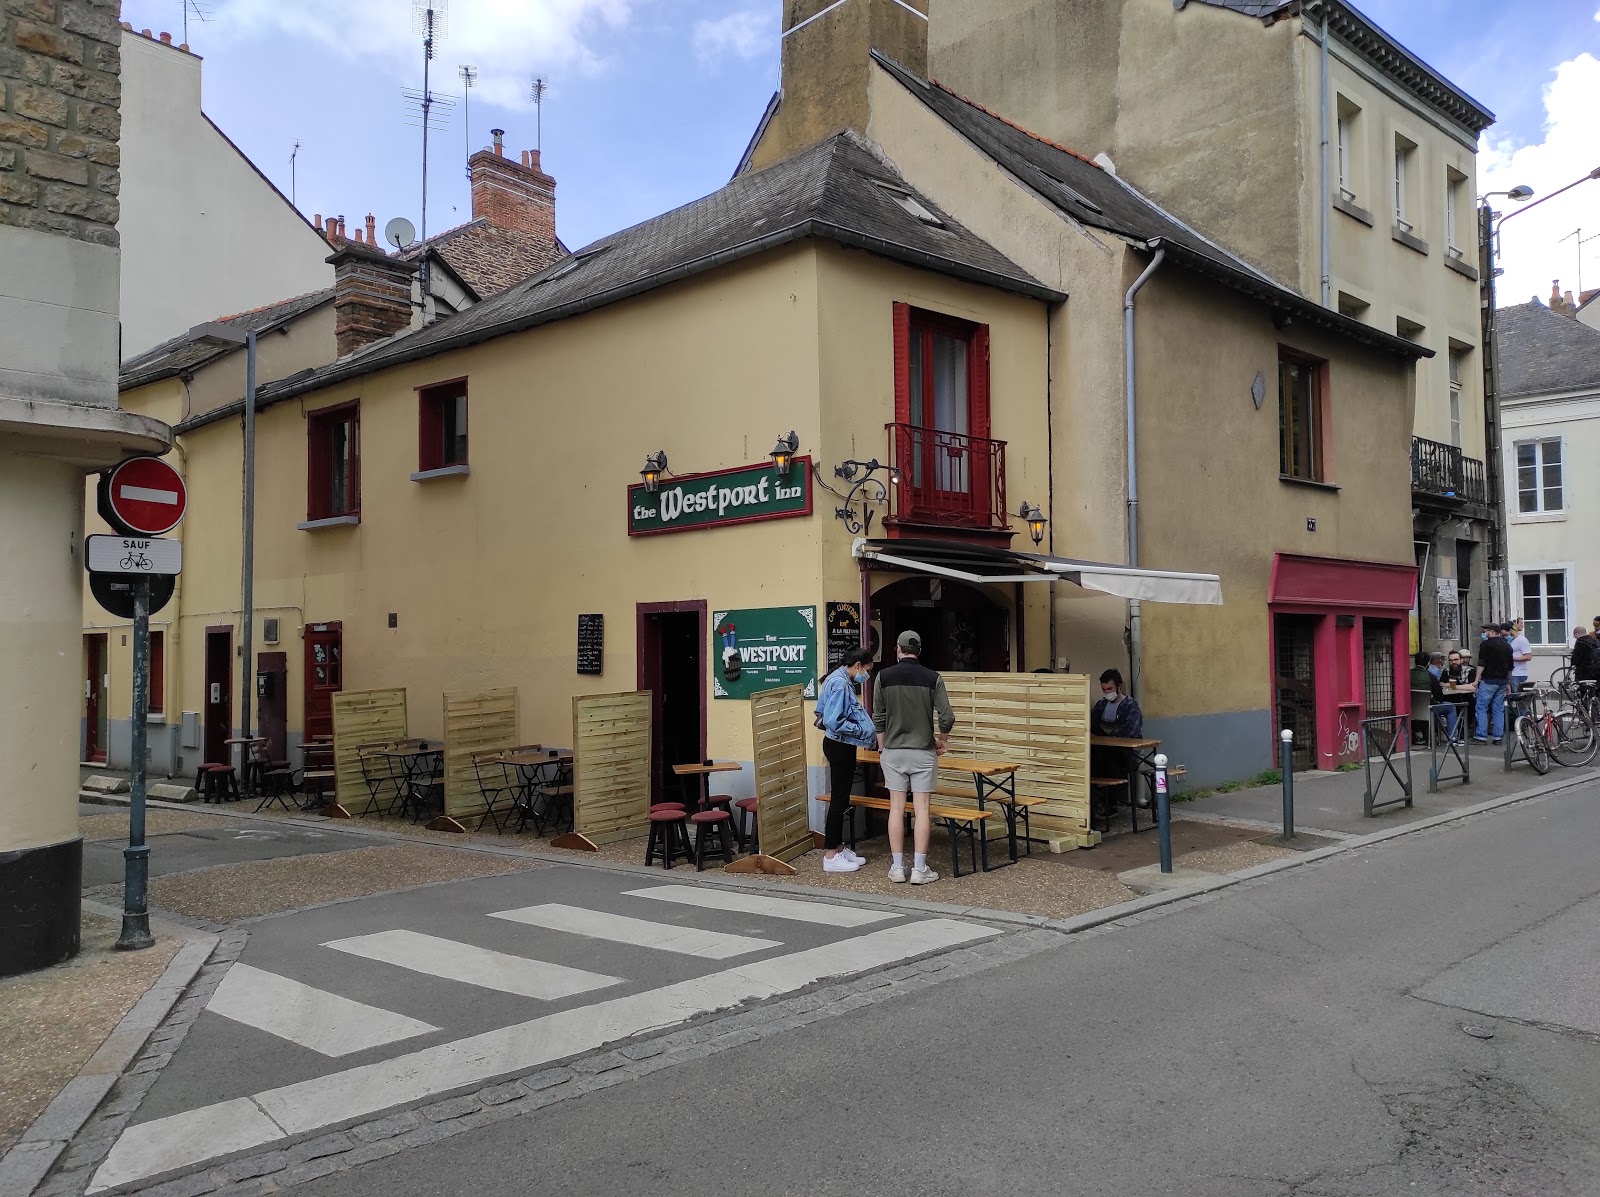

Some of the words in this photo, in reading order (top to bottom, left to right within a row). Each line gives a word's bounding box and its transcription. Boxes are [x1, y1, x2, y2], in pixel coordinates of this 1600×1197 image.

[633, 504, 656, 520] the
[660, 476, 769, 522] Westport
[774, 481, 801, 500] inn
[123, 540, 150, 549] SAUF
[739, 645, 806, 663] WESTPORT
